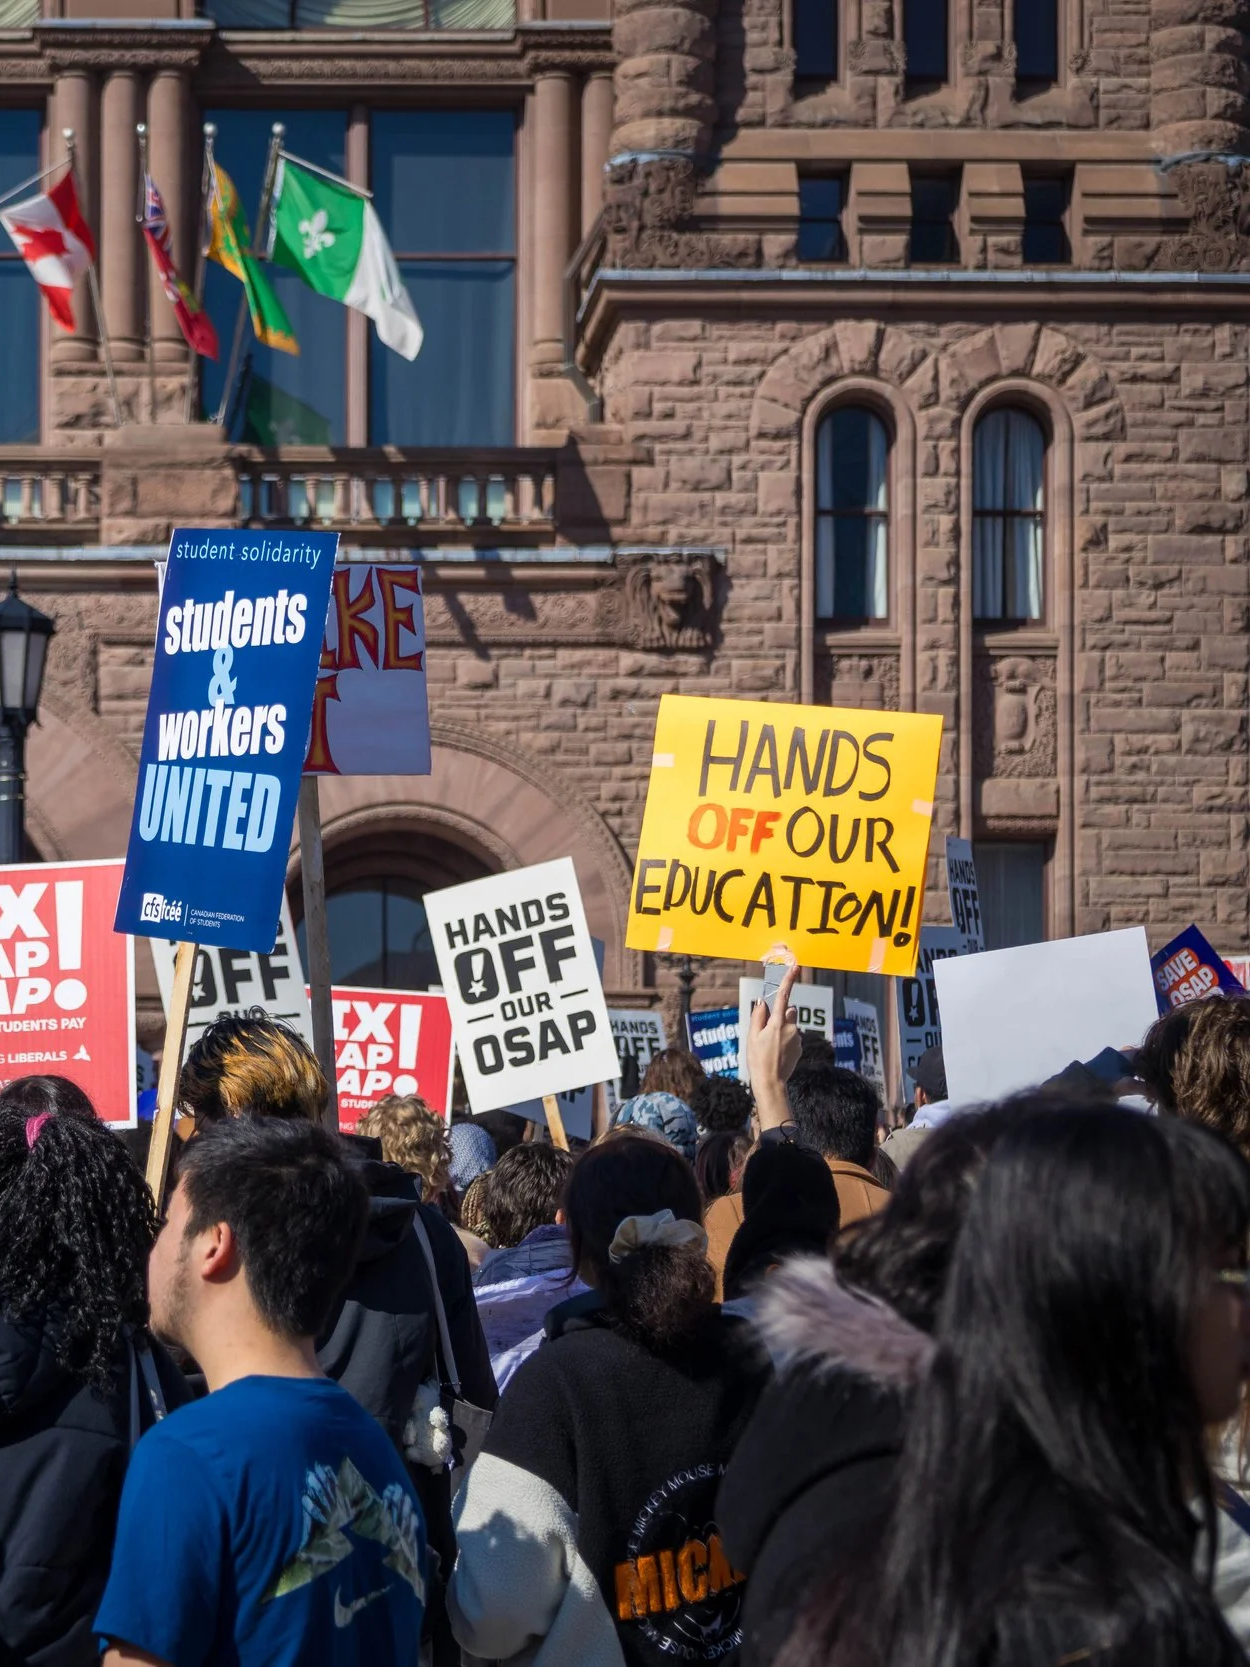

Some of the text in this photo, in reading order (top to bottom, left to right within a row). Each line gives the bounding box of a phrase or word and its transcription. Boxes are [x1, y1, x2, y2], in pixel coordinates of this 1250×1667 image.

[176, 539, 321, 569] student solidarity
[164, 589, 307, 655] students
[320, 566, 424, 671] KE
[208, 644, 237, 707] &
[158, 700, 286, 761] workers
[698, 719, 895, 801] HANDS
[139, 763, 281, 853] UNITED
[687, 803, 900, 874] OFF OUR
[190, 908, 245, 923] CANADIAN FEDERATION
[190, 917, 221, 929] OF STUDENTS
[445, 892, 570, 950] HANDS
[634, 857, 915, 948] EDUCATION!
[454, 924, 577, 1005] OFF
[1156, 950, 1197, 992] SAVE
[1170, 966, 1213, 1006] OSAP
[61, 1017, 86, 1029] PAY
[500, 991, 554, 1022] OUR
[611, 1019, 658, 1034] HANDS
[8, 1051, 67, 1064] LIBERALS
[335, 1042, 393, 1070] AP
[473, 1009, 596, 1076] OSAP
[700, 1052, 739, 1075] work
